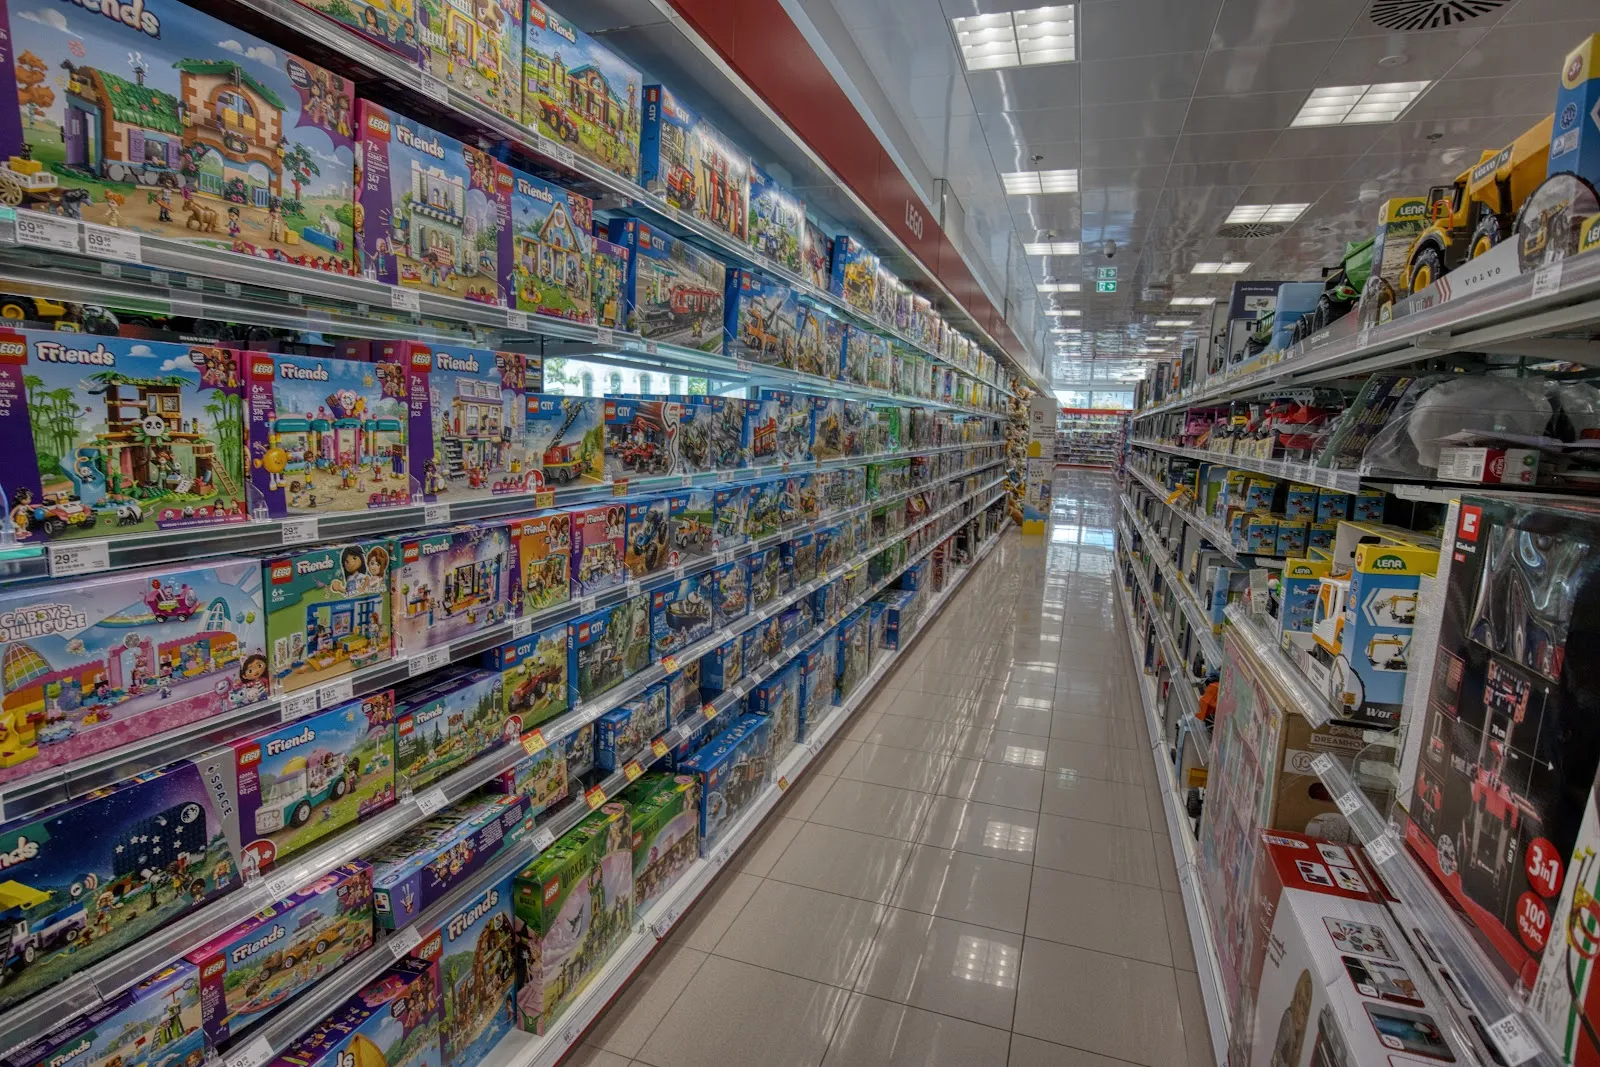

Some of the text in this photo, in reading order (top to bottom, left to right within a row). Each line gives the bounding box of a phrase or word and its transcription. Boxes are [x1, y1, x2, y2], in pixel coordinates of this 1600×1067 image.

[530, 9, 546, 24] LEGO
[549, 17, 576, 43] Friends
[367, 115, 390, 133] LEGO
[396, 124, 445, 159] Friends
[499, 173, 513, 185] LEGO
[517, 178, 553, 204] Friends
[905, 200, 924, 240] LEGO
[1400, 206, 1425, 219] LENA
[1588, 226, 1600, 242] LE
[652, 236, 665, 251] CITY
[1464, 266, 1501, 287] VOLVO
[0, 343, 24, 355] EGO
[34, 341, 116, 366] Friends
[412, 352, 431, 365] LEGO
[436, 352, 479, 374] Friends
[253, 363, 274, 375] LEGO
[279, 362, 329, 382] Friends
[411, 376, 422, 386] 7+
[252, 385, 265, 394] 6+
[540, 401, 554, 411] CITY
[617, 406, 631, 417] CITY
[586, 512, 606, 524] Friends
[638, 506, 648, 515] CITY
[523, 522, 547, 537] Friends
[404, 547, 419, 558] LEGO
[422, 539, 450, 556] Friends
[272, 565, 292, 579] LEGO
[296, 554, 335, 576] Friends
[1294, 567, 1311, 575] LENA
[1376, 559, 1403, 569] LENA
[272, 588, 284, 598] 6+
[664, 590, 674, 602] CITY
[1, 604, 71, 629] GABBY'S
[0, 614, 87, 643] OLLHOUSE
[591, 620, 604, 635] CITY
[518, 643, 531, 656] CITY
[416, 703, 443, 724] Friends
[399, 718, 414, 732] LEGO
[266, 726, 316, 758] Friends
[239, 749, 261, 765] LEGO
[718, 761, 729, 777] CITY
[210, 774, 233, 817] SPACE
[561, 854, 587, 889] WICKED
[544, 881, 560, 902] LEGO
[447, 888, 500, 941] Friends
[1525, 898, 1546, 930] 100
[232, 924, 286, 964] Friends
[421, 936, 442, 959] LEGO
[203, 958, 226, 979] LEGO
[50, 1039, 92, 1067] Friends
